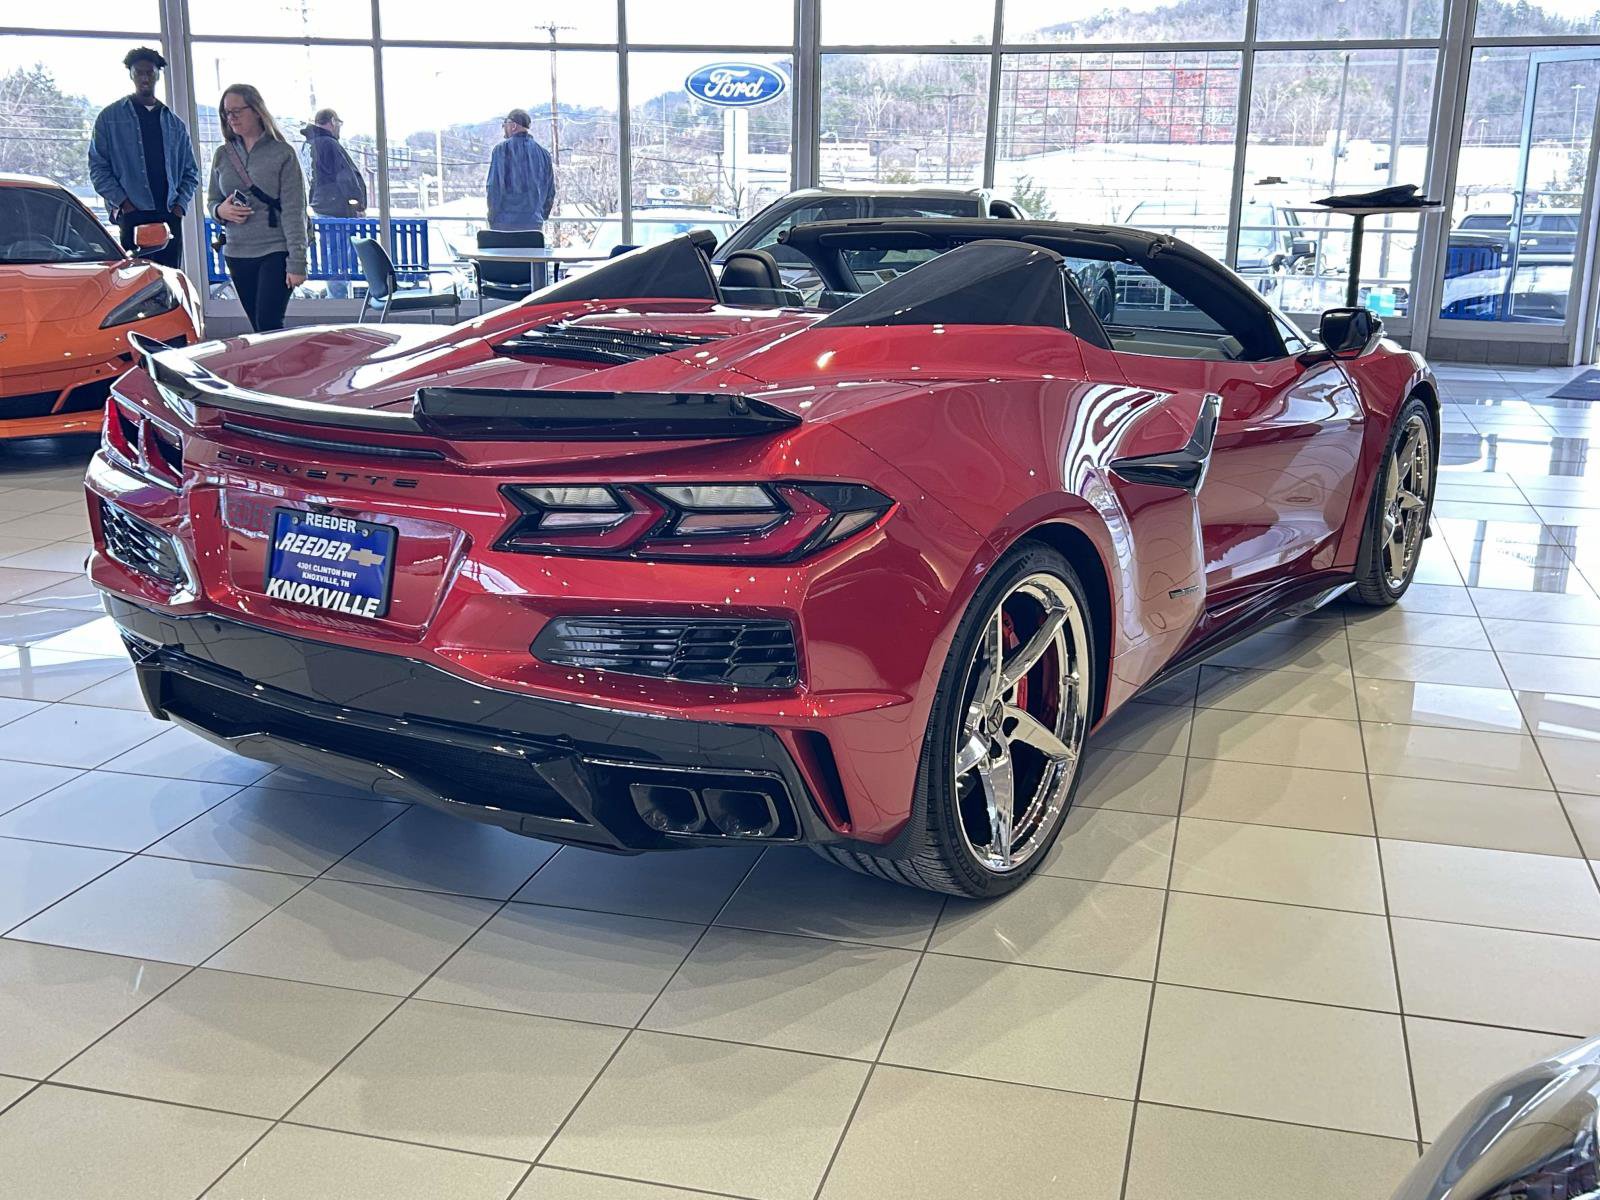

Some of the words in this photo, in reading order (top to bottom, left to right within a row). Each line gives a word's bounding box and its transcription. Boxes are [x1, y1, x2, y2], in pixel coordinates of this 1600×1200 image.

[703, 68, 765, 98] Ford
[216, 450, 419, 488] CORVETTE
[305, 512, 357, 534] REEDER
[278, 532, 352, 562] REEDER
[296, 561, 312, 572] 4301
[312, 564, 341, 577] CLINTON
[341, 569, 358, 580] HWY
[301, 572, 339, 586] KNOXVILLE,
[340, 579, 350, 588] TN
[265, 577, 381, 618] KNOXVILLE
